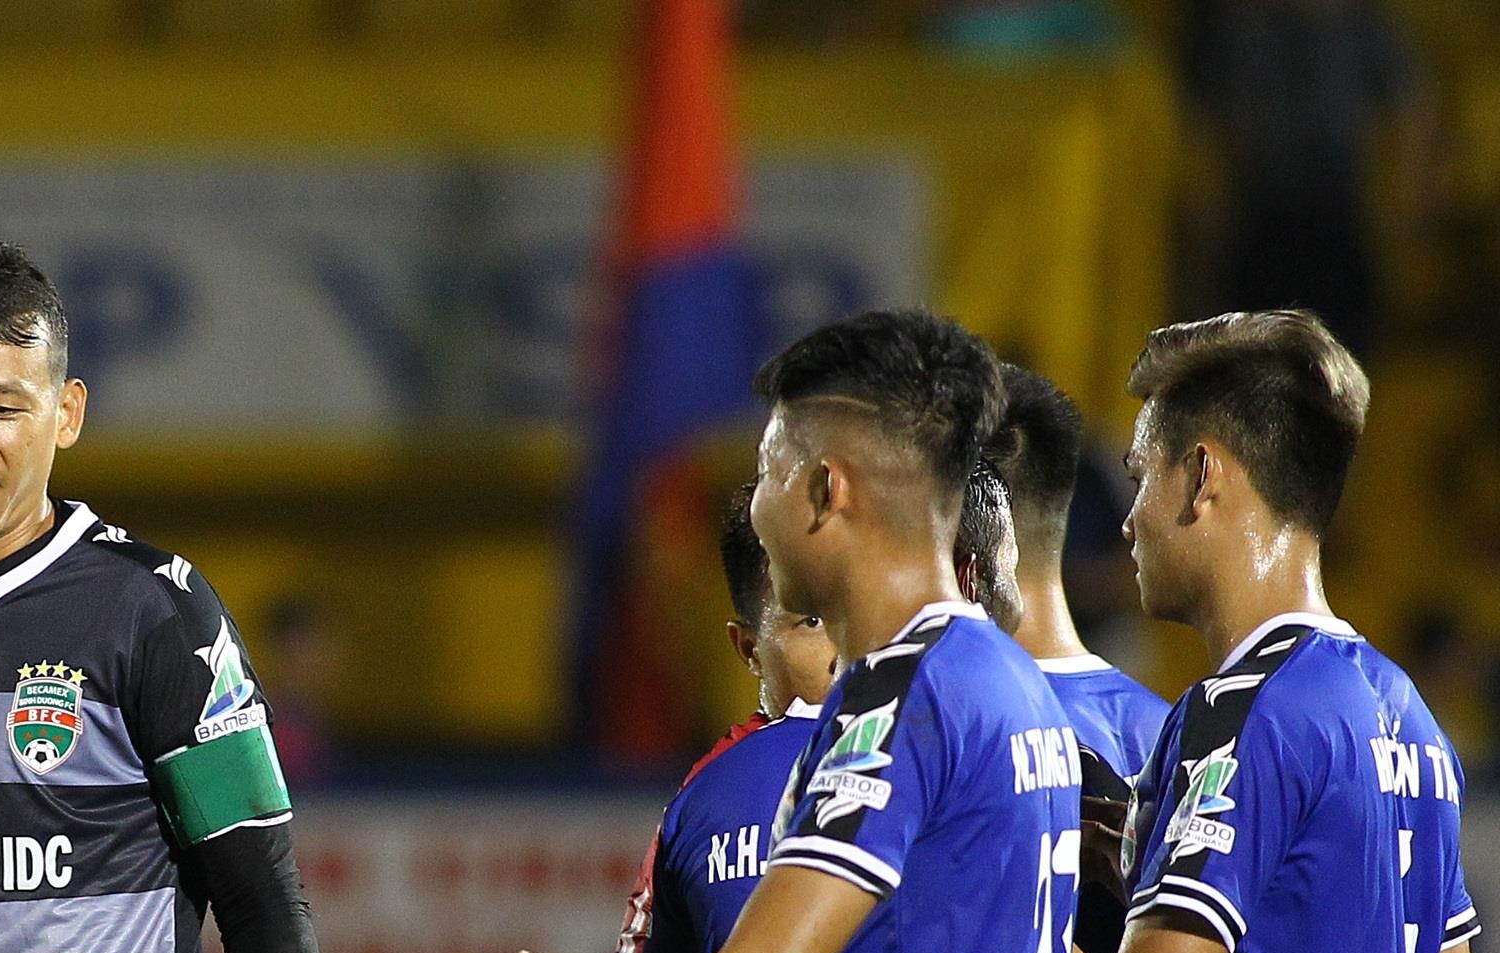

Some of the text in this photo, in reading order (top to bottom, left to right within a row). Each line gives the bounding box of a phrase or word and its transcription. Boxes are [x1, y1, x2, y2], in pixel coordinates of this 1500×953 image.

[26, 684, 70, 698] BECAMEX
[64, 702, 75, 711] FC
[27, 709, 62, 724] BFC
[2, 834, 73, 891] IDC
